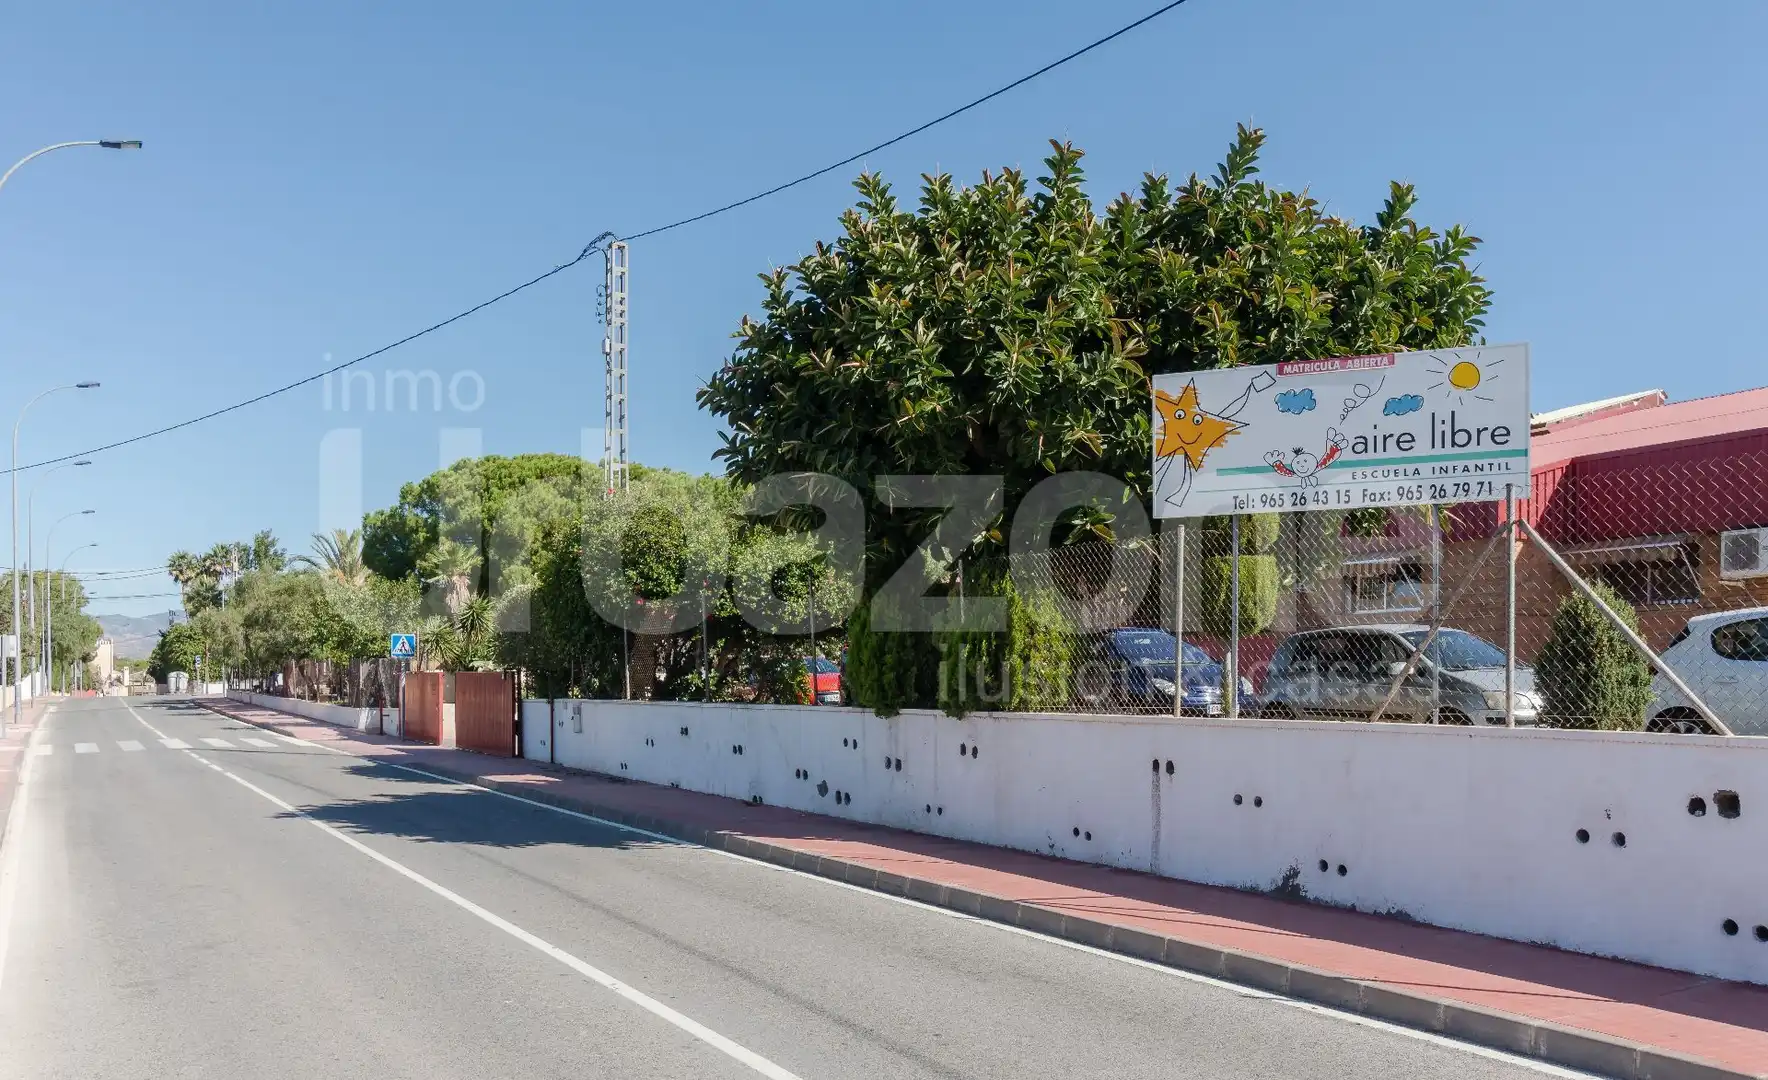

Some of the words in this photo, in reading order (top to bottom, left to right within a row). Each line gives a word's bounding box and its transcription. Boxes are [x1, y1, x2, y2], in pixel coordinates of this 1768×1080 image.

[1346, 356, 1389, 369] ABIERTA
[1352, 424, 1416, 455] aire
[1431, 410, 1511, 449] libre
[1351, 467, 1421, 480] ESCUELA
[1432, 461, 1512, 475] INFANTIL
[1233, 493, 1255, 510] Tel:
[1261, 493, 1285, 508] 965
[1290, 492, 1307, 507] 26
[1312, 490, 1329, 505] 43
[1336, 489, 1351, 504] 15
[1362, 488, 1391, 503] Fax:
[1397, 485, 1423, 501] 965
[1429, 484, 1447, 500] 26
[1453, 482, 1471, 498] 79
[1476, 481, 1493, 497] 71
